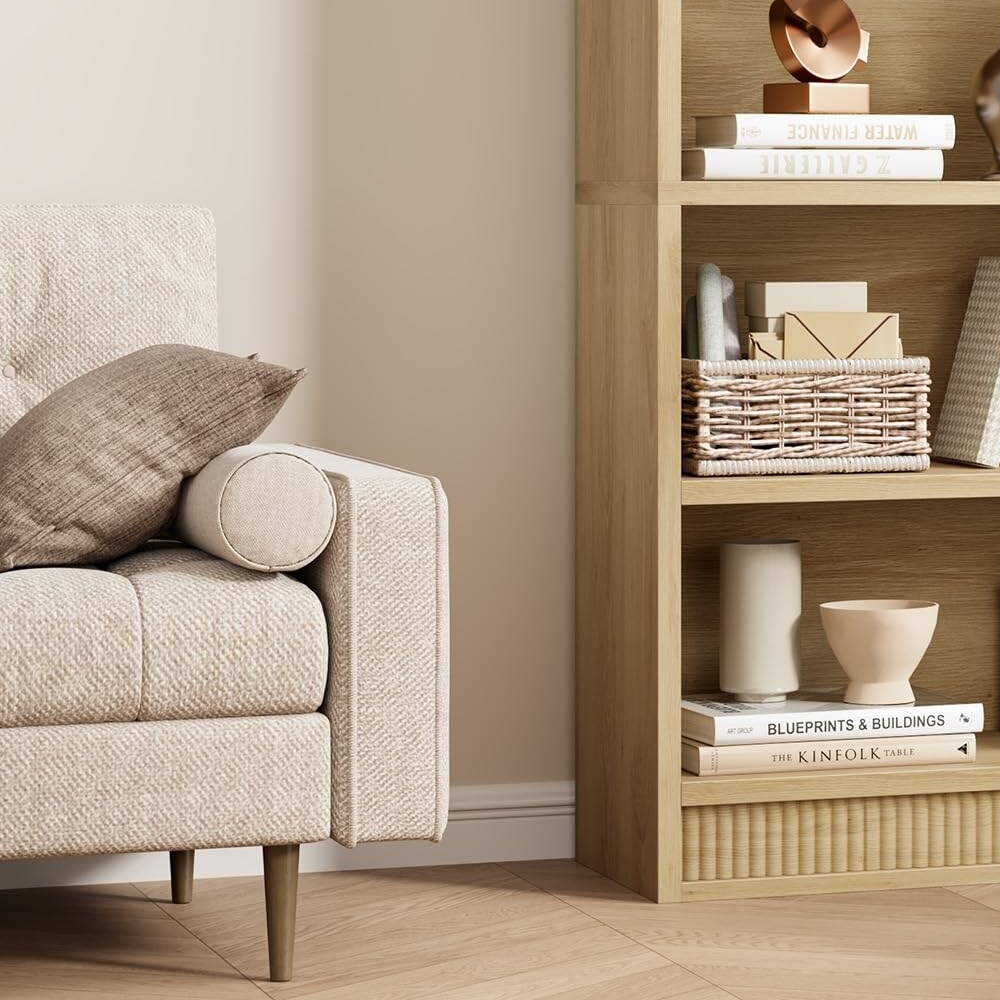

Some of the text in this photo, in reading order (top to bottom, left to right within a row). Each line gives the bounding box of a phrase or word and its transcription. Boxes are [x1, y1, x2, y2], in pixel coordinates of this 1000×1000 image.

[787, 123, 918, 141] WATER FINANCE
[760, 154, 868, 174] GALLERIE
[767, 714, 946, 736] BLUEPRINTS & BUILDINGS
[771, 747, 916, 764] THE KINFOLK TABLE
